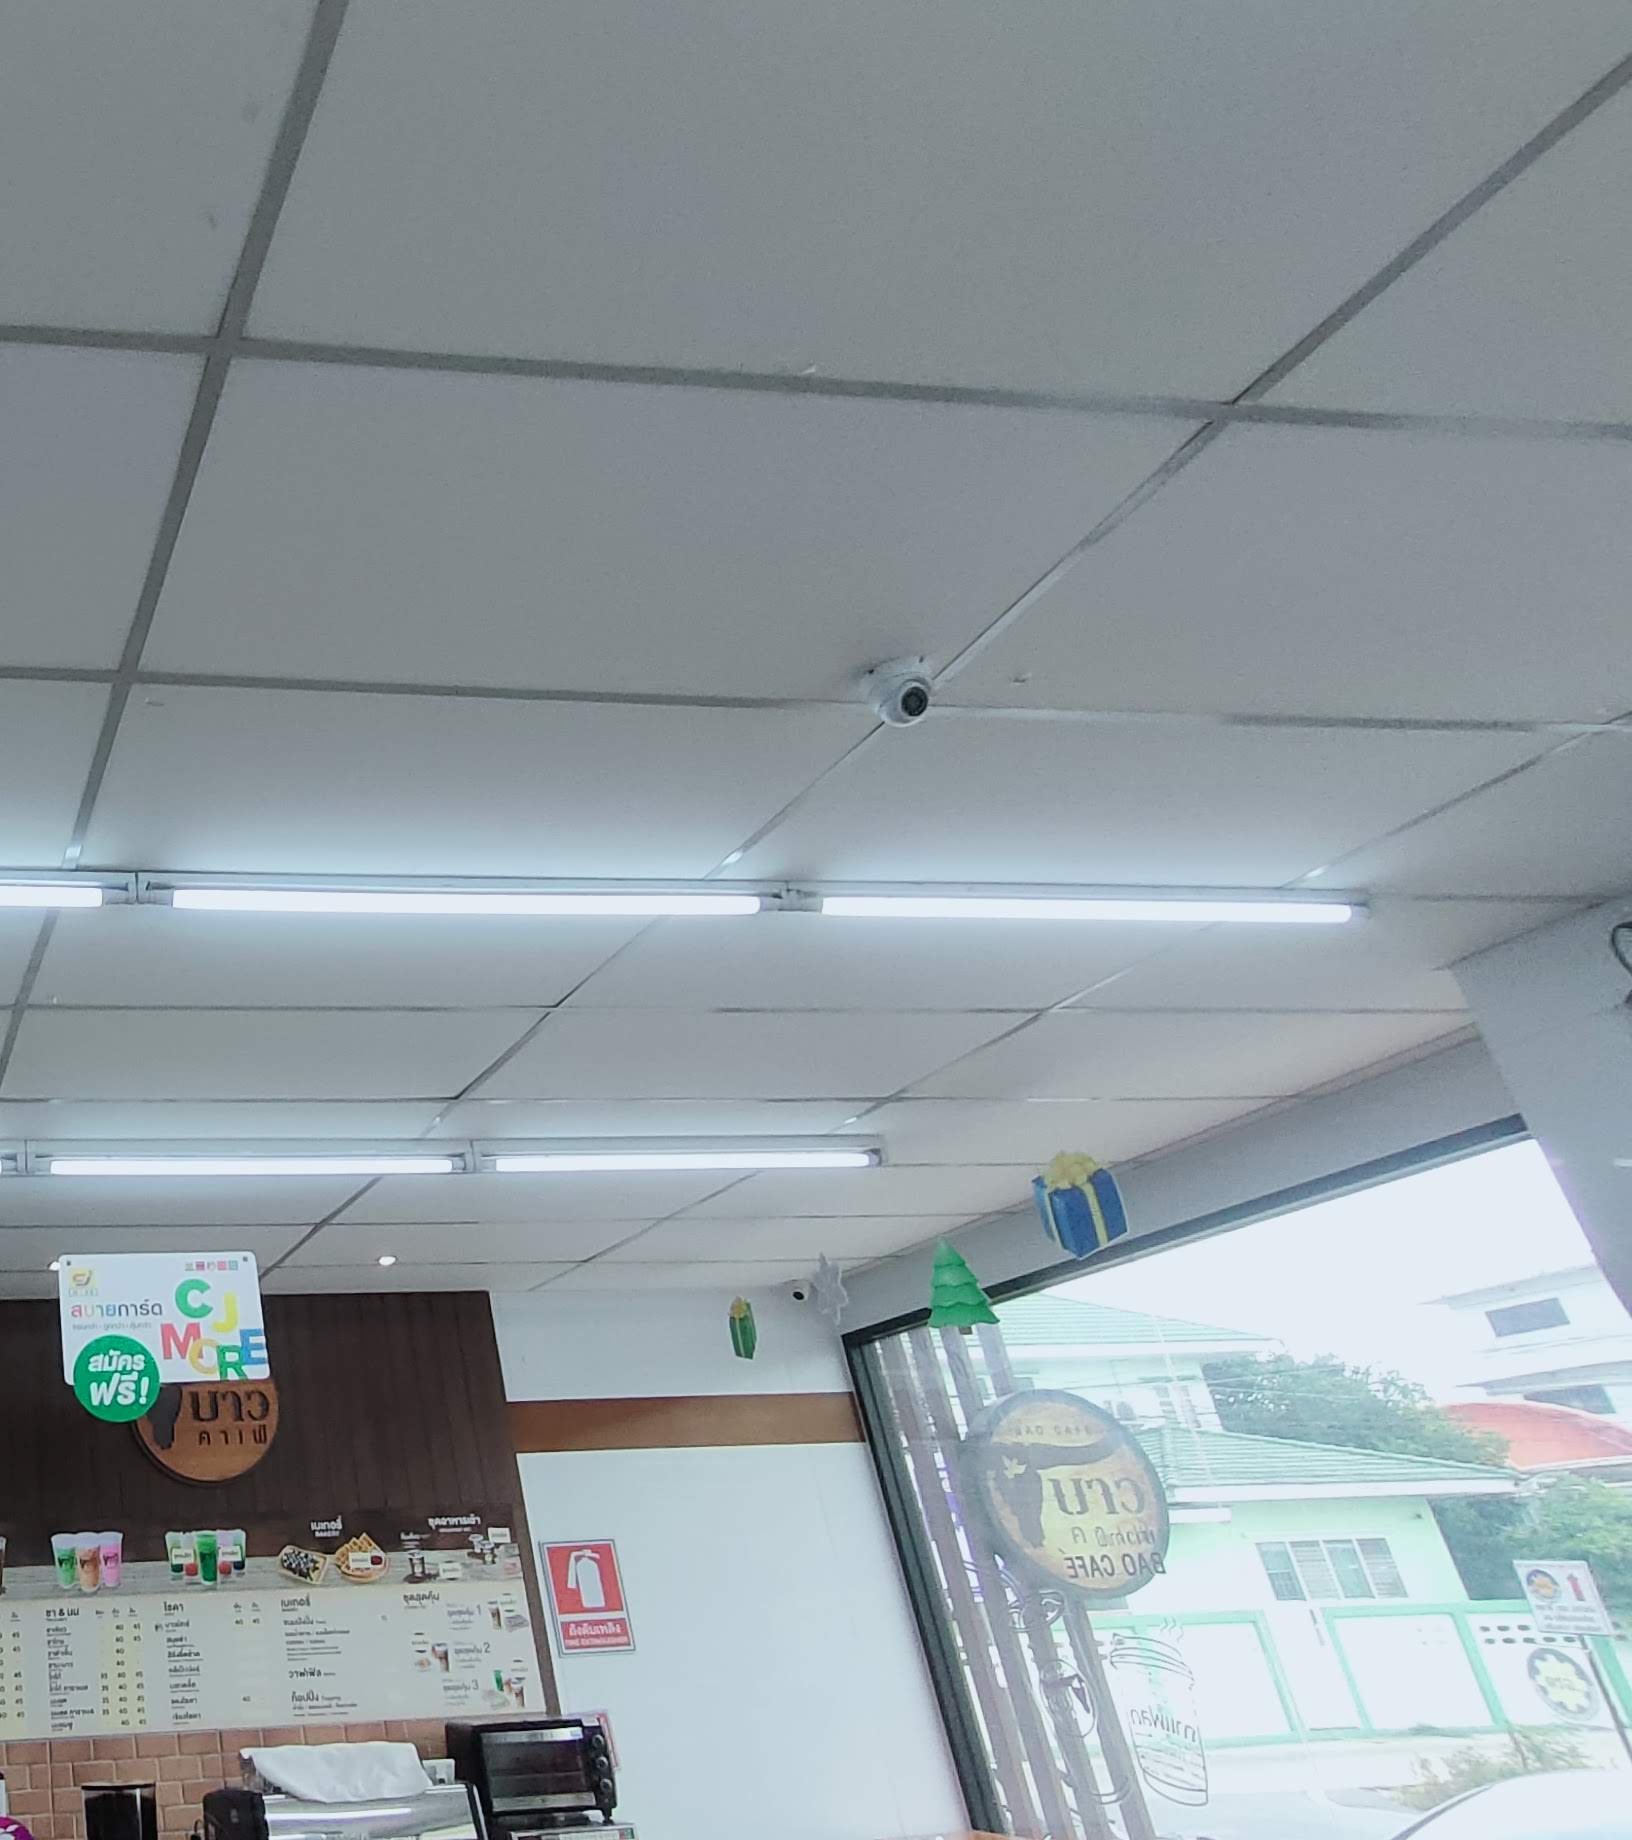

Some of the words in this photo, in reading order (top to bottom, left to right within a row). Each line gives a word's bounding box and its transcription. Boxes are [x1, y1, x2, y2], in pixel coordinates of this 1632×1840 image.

[70, 1298, 163, 1318] สบายการ์ด
[88, 1349, 145, 1373] สมัคร
[89, 1371, 150, 1407] ฟรี!
[190, 1389, 269, 1423] บาว
